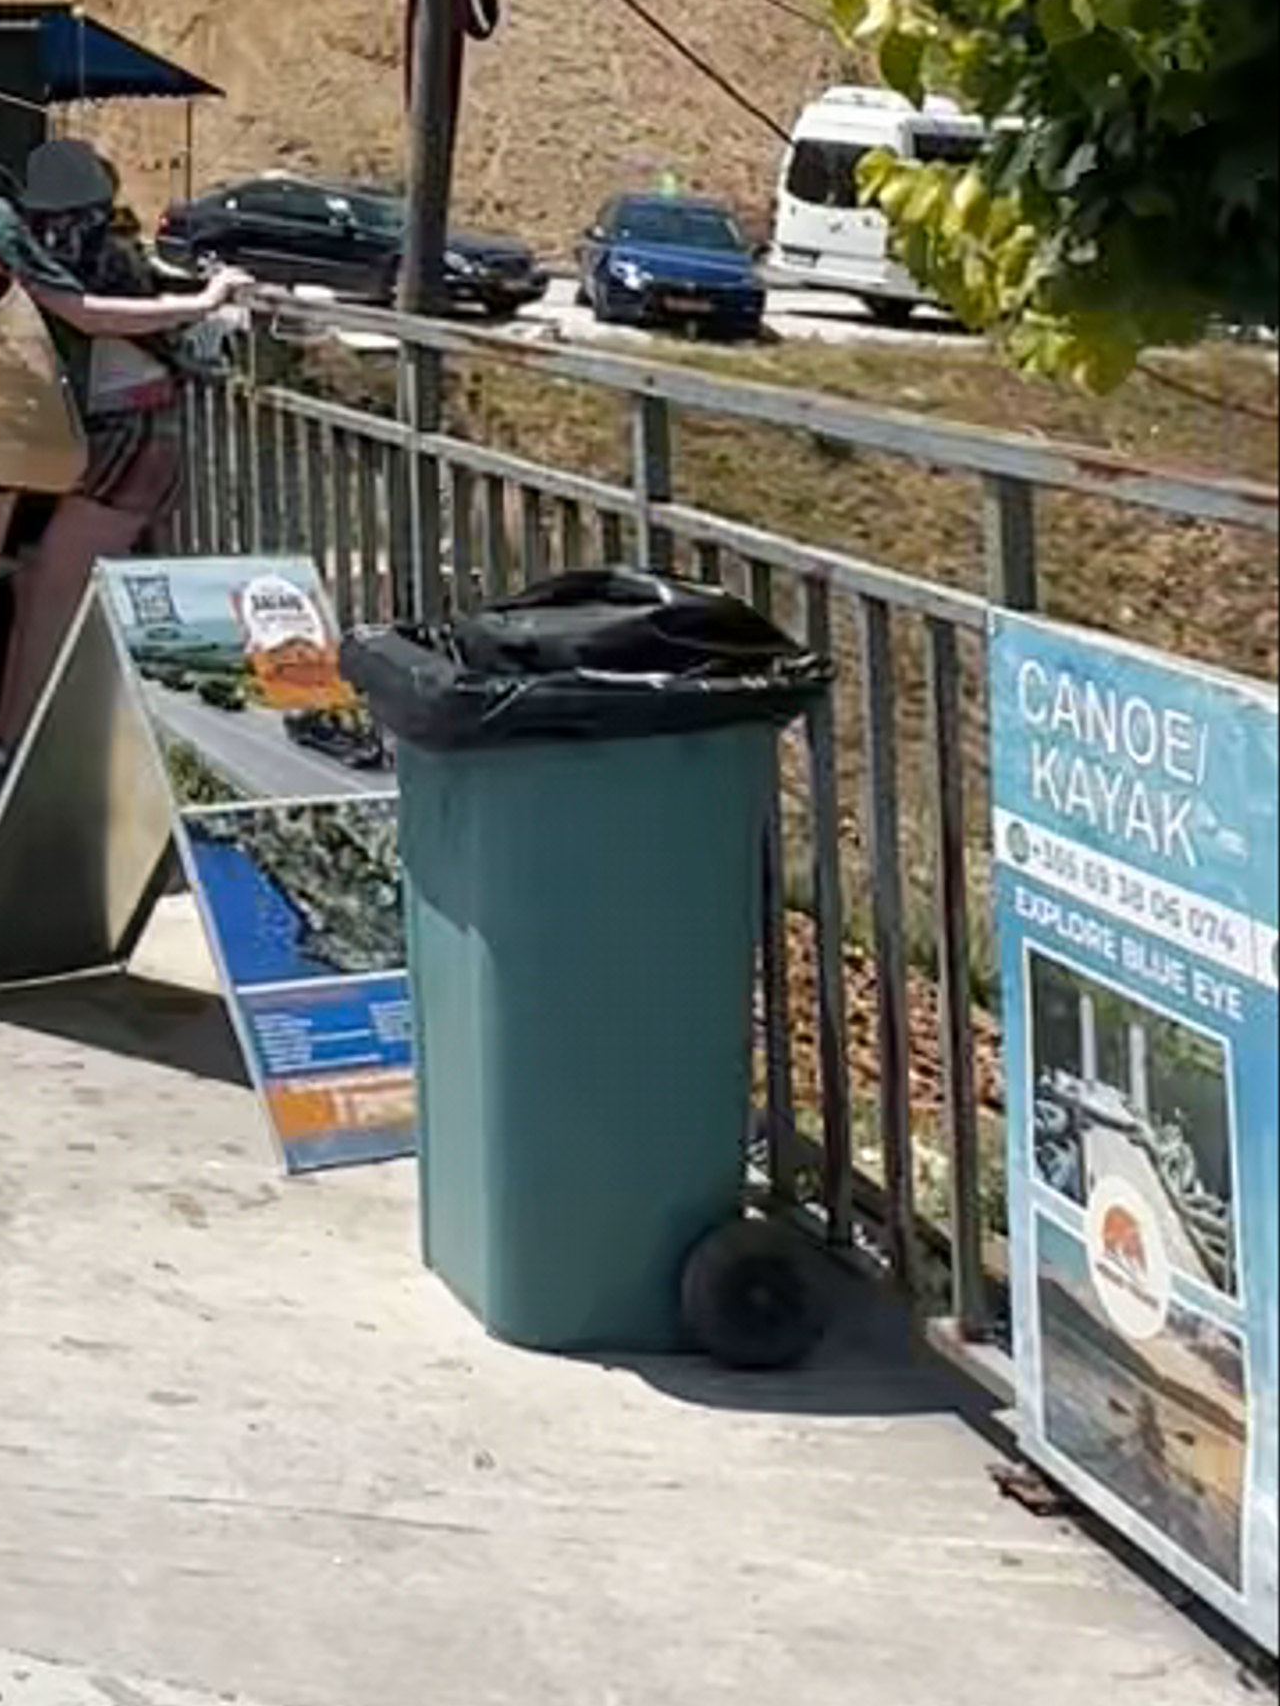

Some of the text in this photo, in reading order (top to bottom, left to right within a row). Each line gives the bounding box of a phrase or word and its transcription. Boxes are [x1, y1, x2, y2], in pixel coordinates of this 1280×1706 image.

[1017, 658, 1208, 786] CANOE/
[1031, 739, 1197, 868] KAYAK
[1014, 885, 1245, 1022] EXPLORE BLUE EYE
